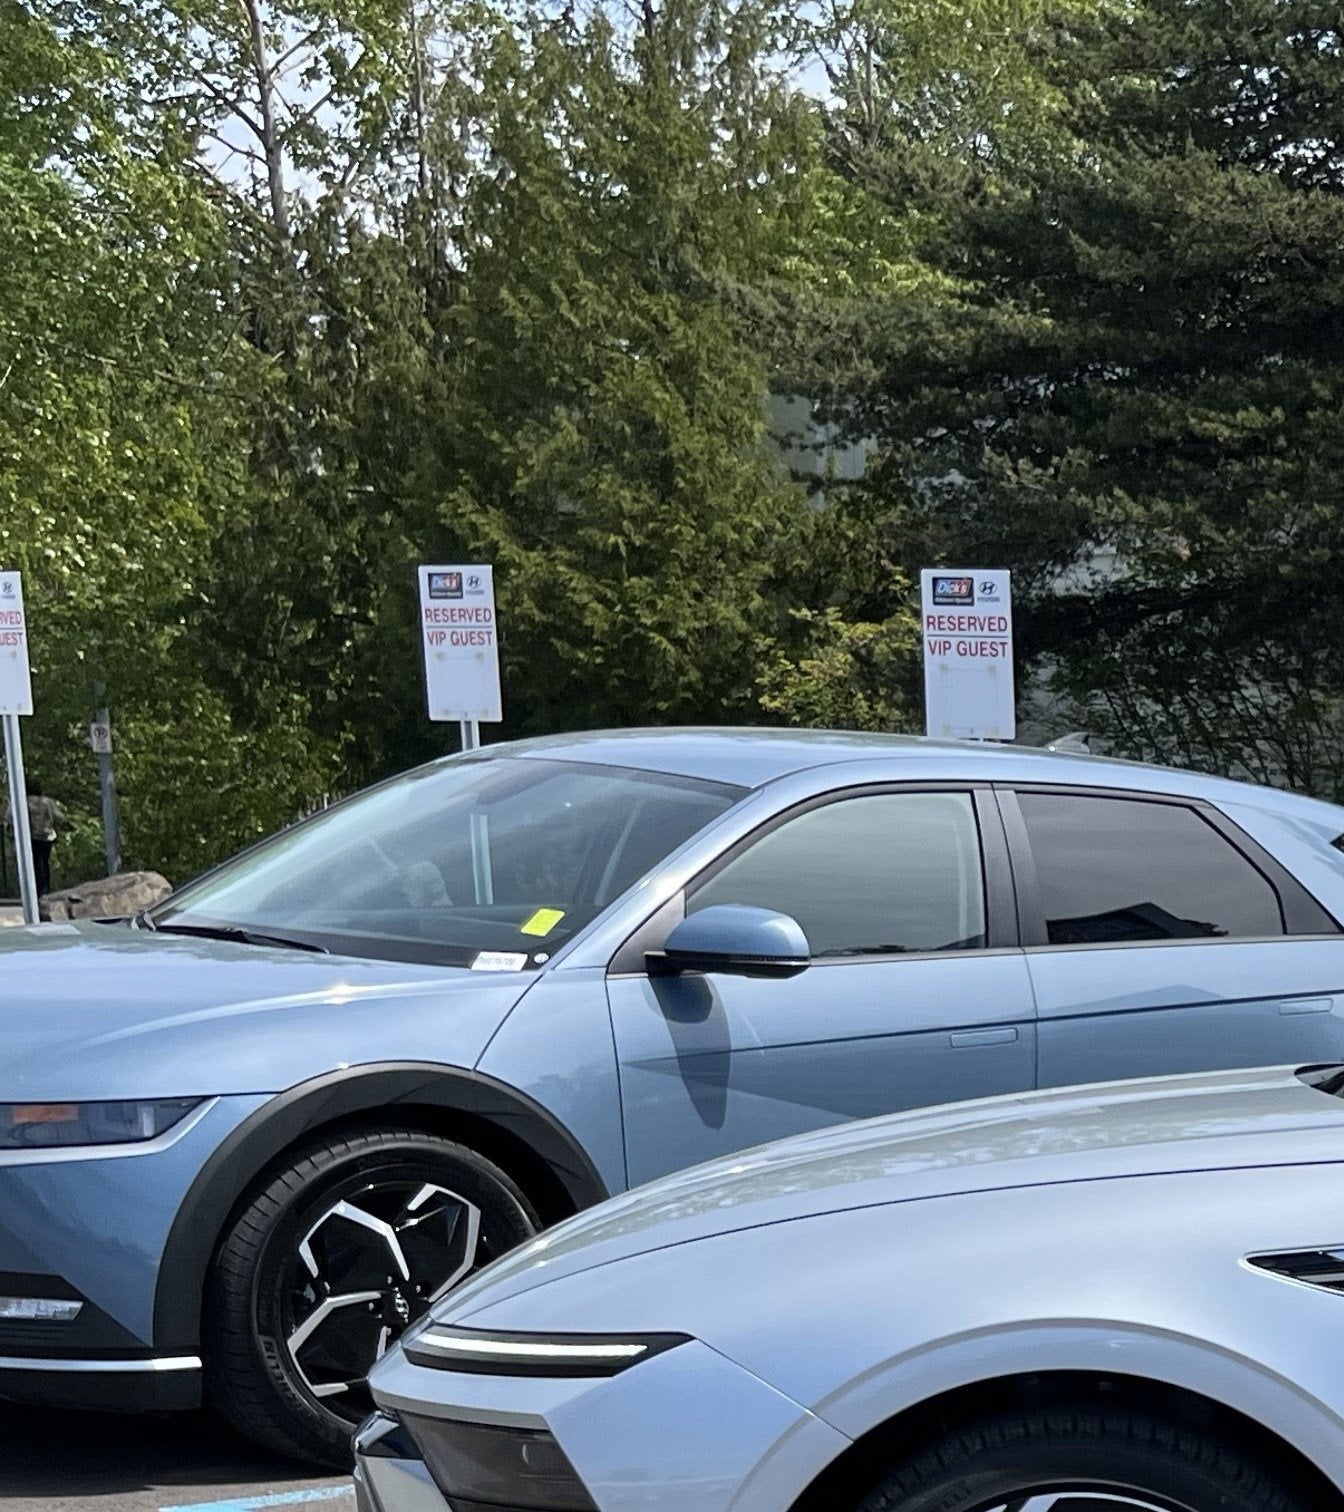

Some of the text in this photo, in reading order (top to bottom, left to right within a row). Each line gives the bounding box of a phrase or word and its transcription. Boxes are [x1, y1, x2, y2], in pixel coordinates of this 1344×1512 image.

[425, 608, 492, 623] RESERVED
[926, 615, 1008, 632] RESERVED
[427, 631, 492, 646] VIP GUEST
[928, 640, 1008, 657] VIP GUEST
